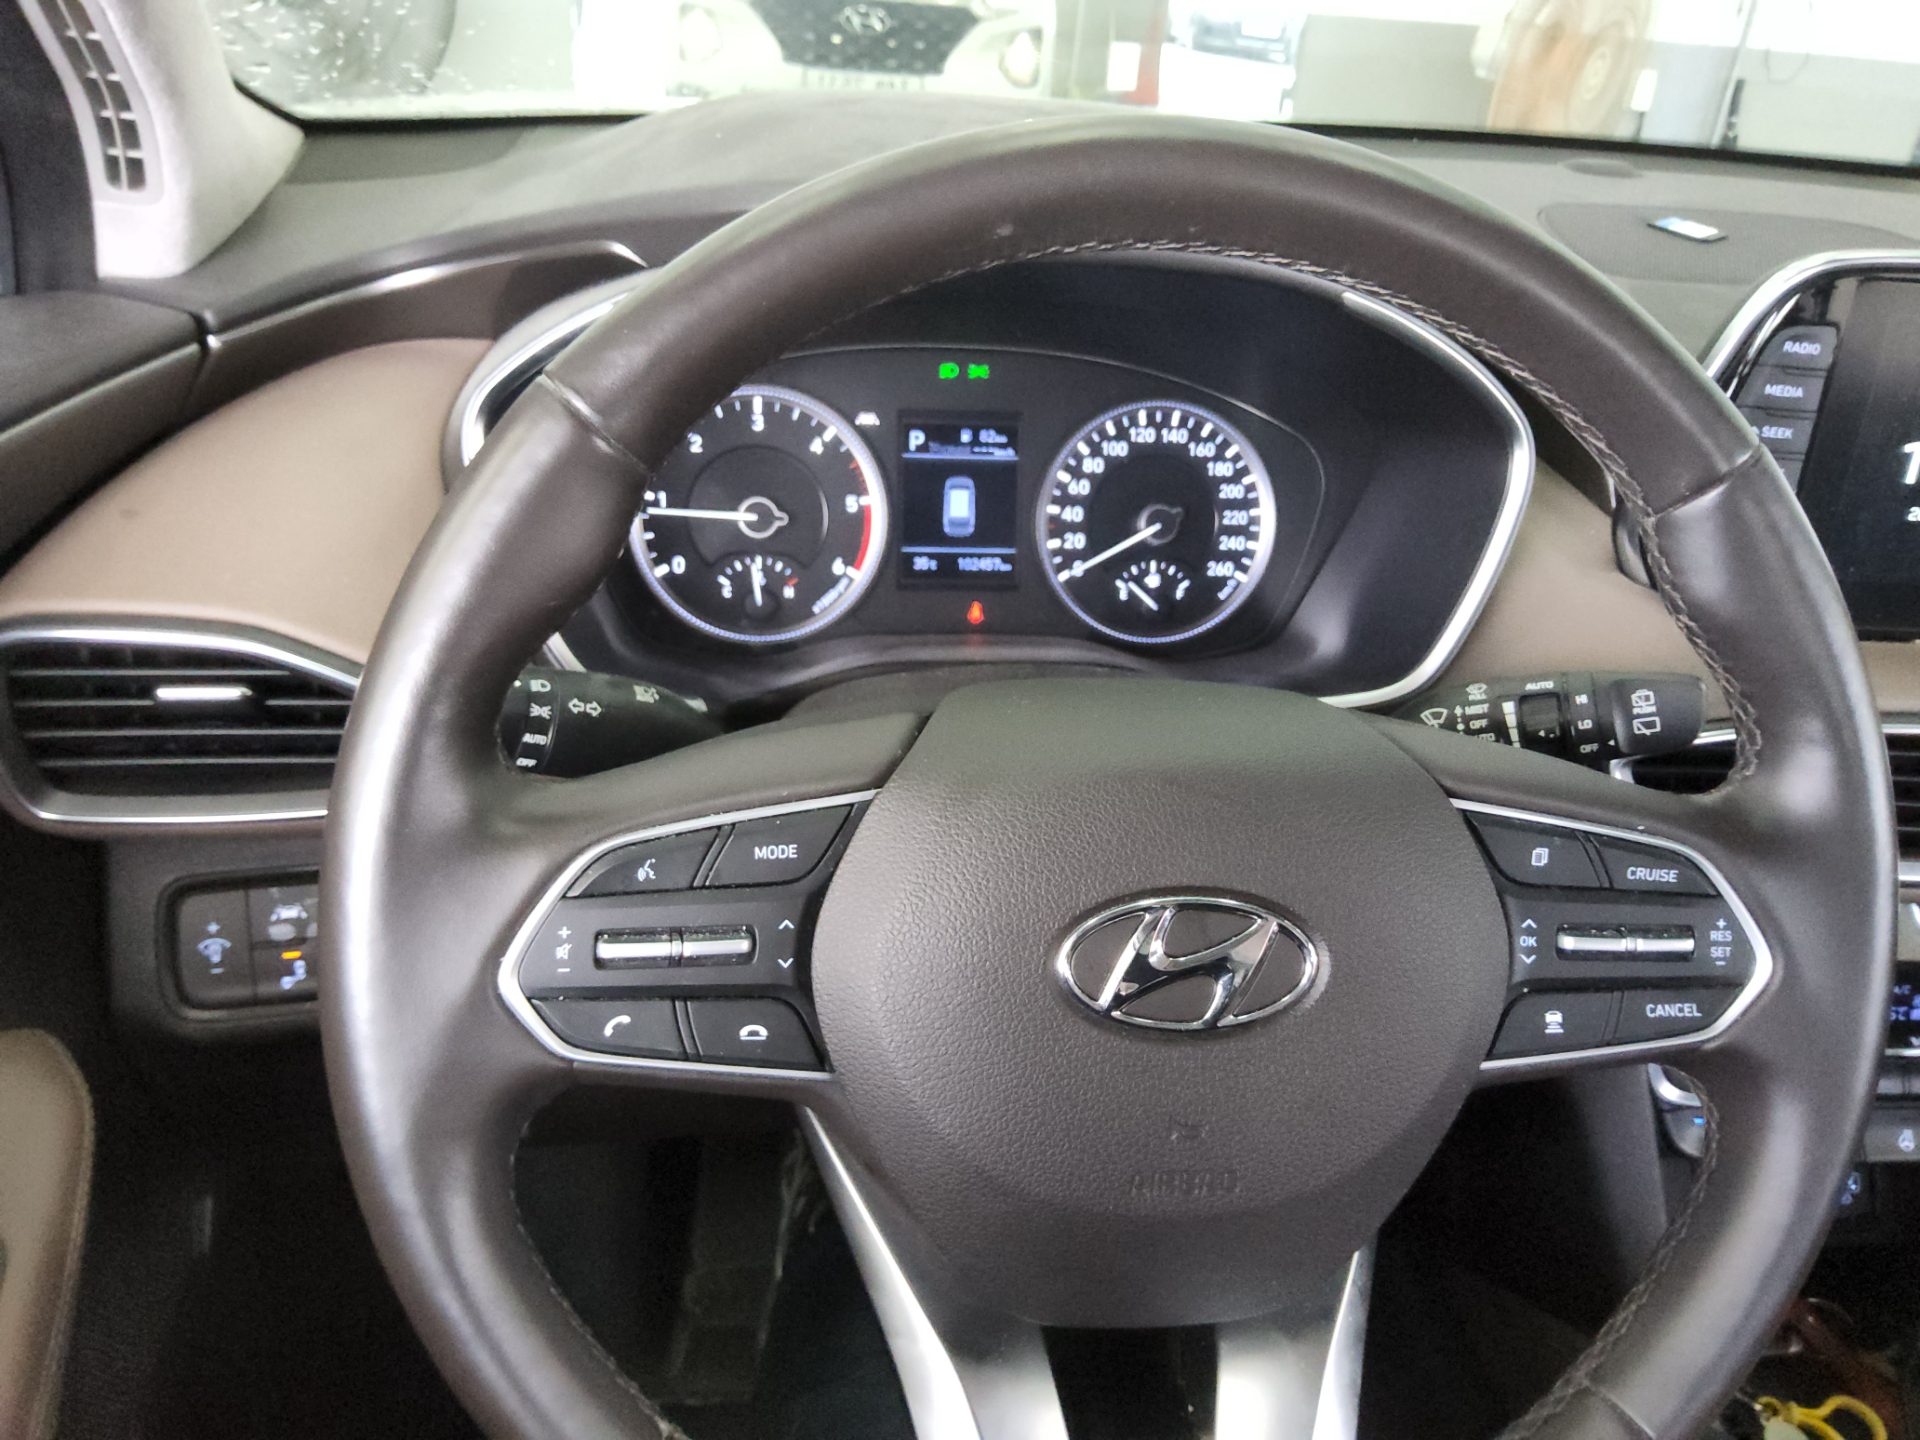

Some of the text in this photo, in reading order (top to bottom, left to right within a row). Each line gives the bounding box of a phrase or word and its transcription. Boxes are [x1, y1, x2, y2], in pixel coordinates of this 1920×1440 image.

[1783, 340, 1821, 356] RADIO
[1764, 383, 1804, 399] MEDIA
[751, 414, 765, 432] 3
[908, 428, 926, 452] P
[1129, 427, 1157, 444] 120
[1161, 428, 1189, 445] 140
[1761, 426, 1793, 440] SEEK
[688, 433, 703, 454] 2
[809, 437, 824, 455] 4
[1101, 440, 1129, 458] 100
[1188, 442, 1217, 459] 160
[1082, 456, 1106, 474] 80
[1206, 462, 1235, 477] 180
[1067, 479, 1092, 496] 60
[1218, 484, 1246, 500] 200
[845, 494, 858, 513] 5
[1061, 510, 1085, 523] 40
[1222, 509, 1249, 526] 220
[1062, 531, 1087, 550] 20
[1218, 536, 1247, 552] 240
[671, 555, 686, 574] 0
[832, 556, 846, 576] 6
[1206, 560, 1236, 577] 260
[1525, 681, 1555, 690] AUTO
[1469, 718, 1489, 730] OFF
[1577, 718, 1593, 730] LO
[522, 732, 547, 746] AUTO
[1474, 732, 1496, 742] UTO
[1579, 742, 1600, 754] OFF
[515, 757, 538, 768] OFF
[754, 843, 798, 860] MODE
[1626, 866, 1680, 884] CRUISE
[1519, 936, 1537, 948] OK
[1710, 931, 1733, 943] RES
[1710, 947, 1732, 959] SET
[1645, 1003, 1702, 1019] CANCEL
